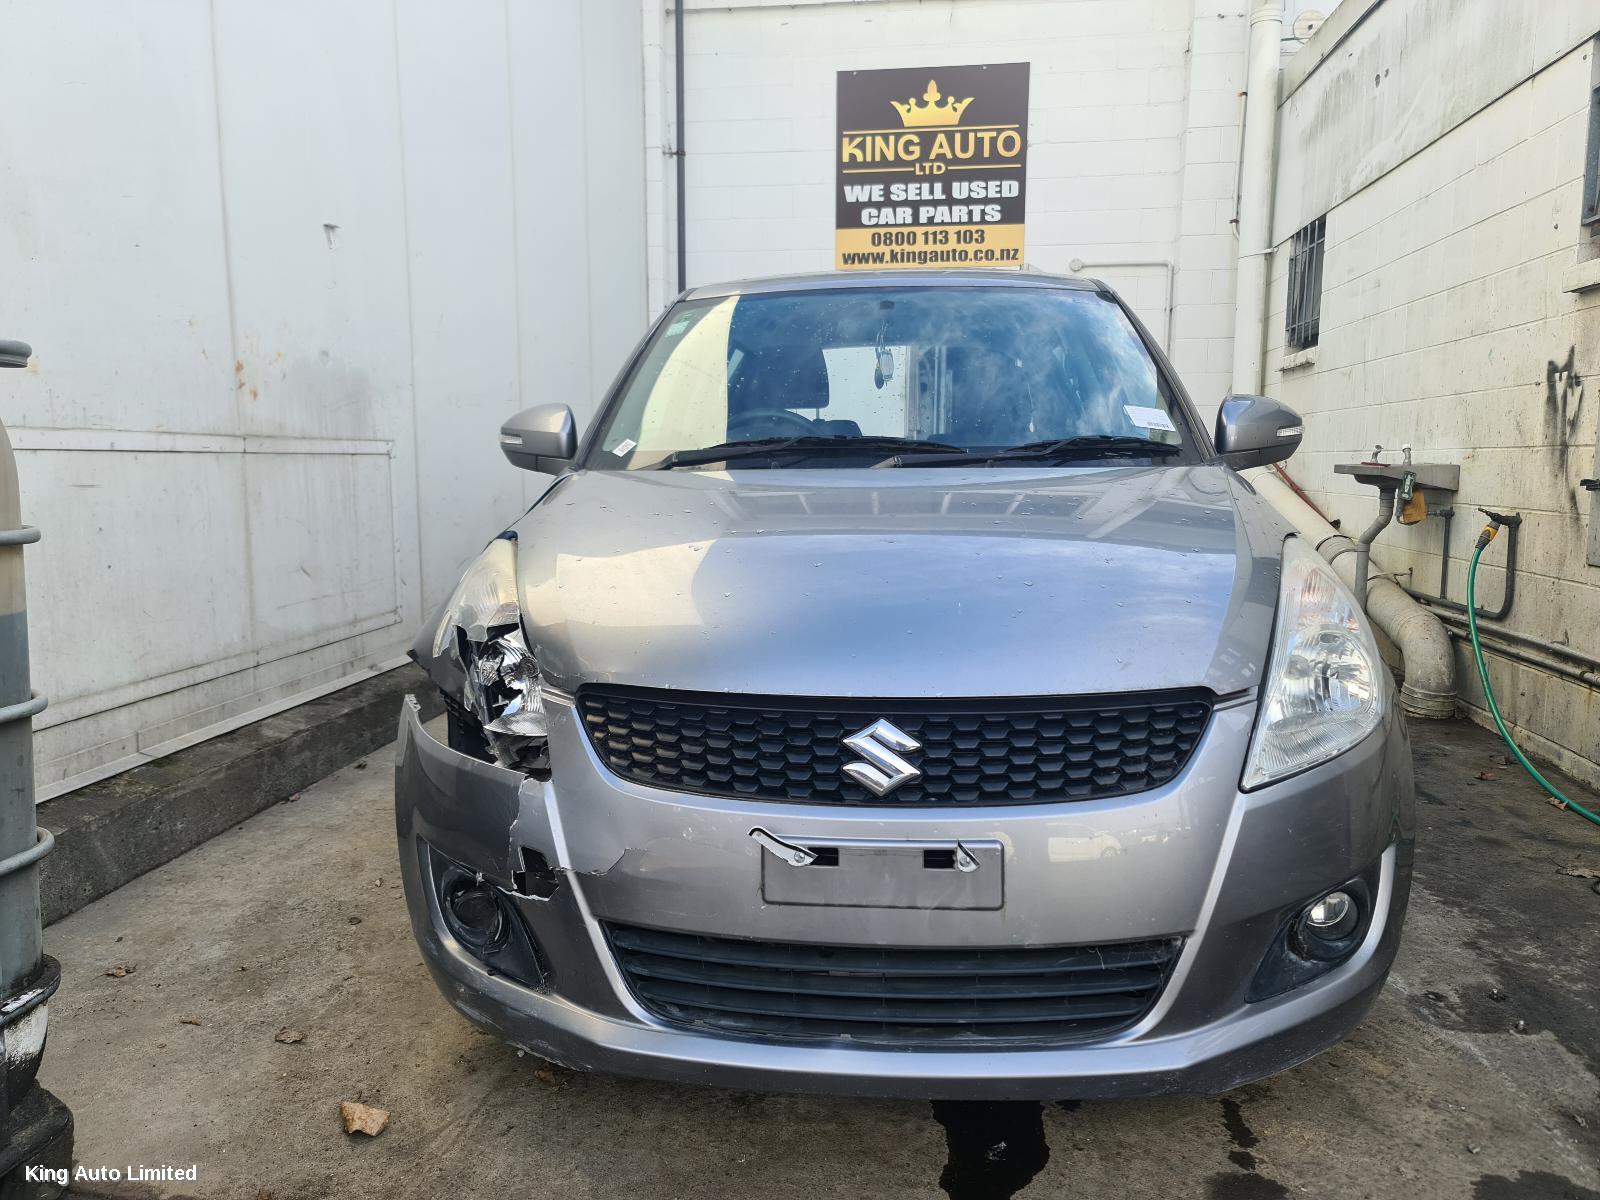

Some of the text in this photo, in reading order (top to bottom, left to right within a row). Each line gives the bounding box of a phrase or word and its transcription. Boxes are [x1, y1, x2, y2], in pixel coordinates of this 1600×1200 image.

[842, 131, 1021, 162] KING AUTO
[915, 163, 946, 175] LTD
[844, 180, 1019, 202] WE SELL USED
[861, 204, 1001, 225] CAR PARTS
[871, 229, 985, 247] 0800 113 103
[842, 248, 1019, 265] www.kingauto.co.nz
